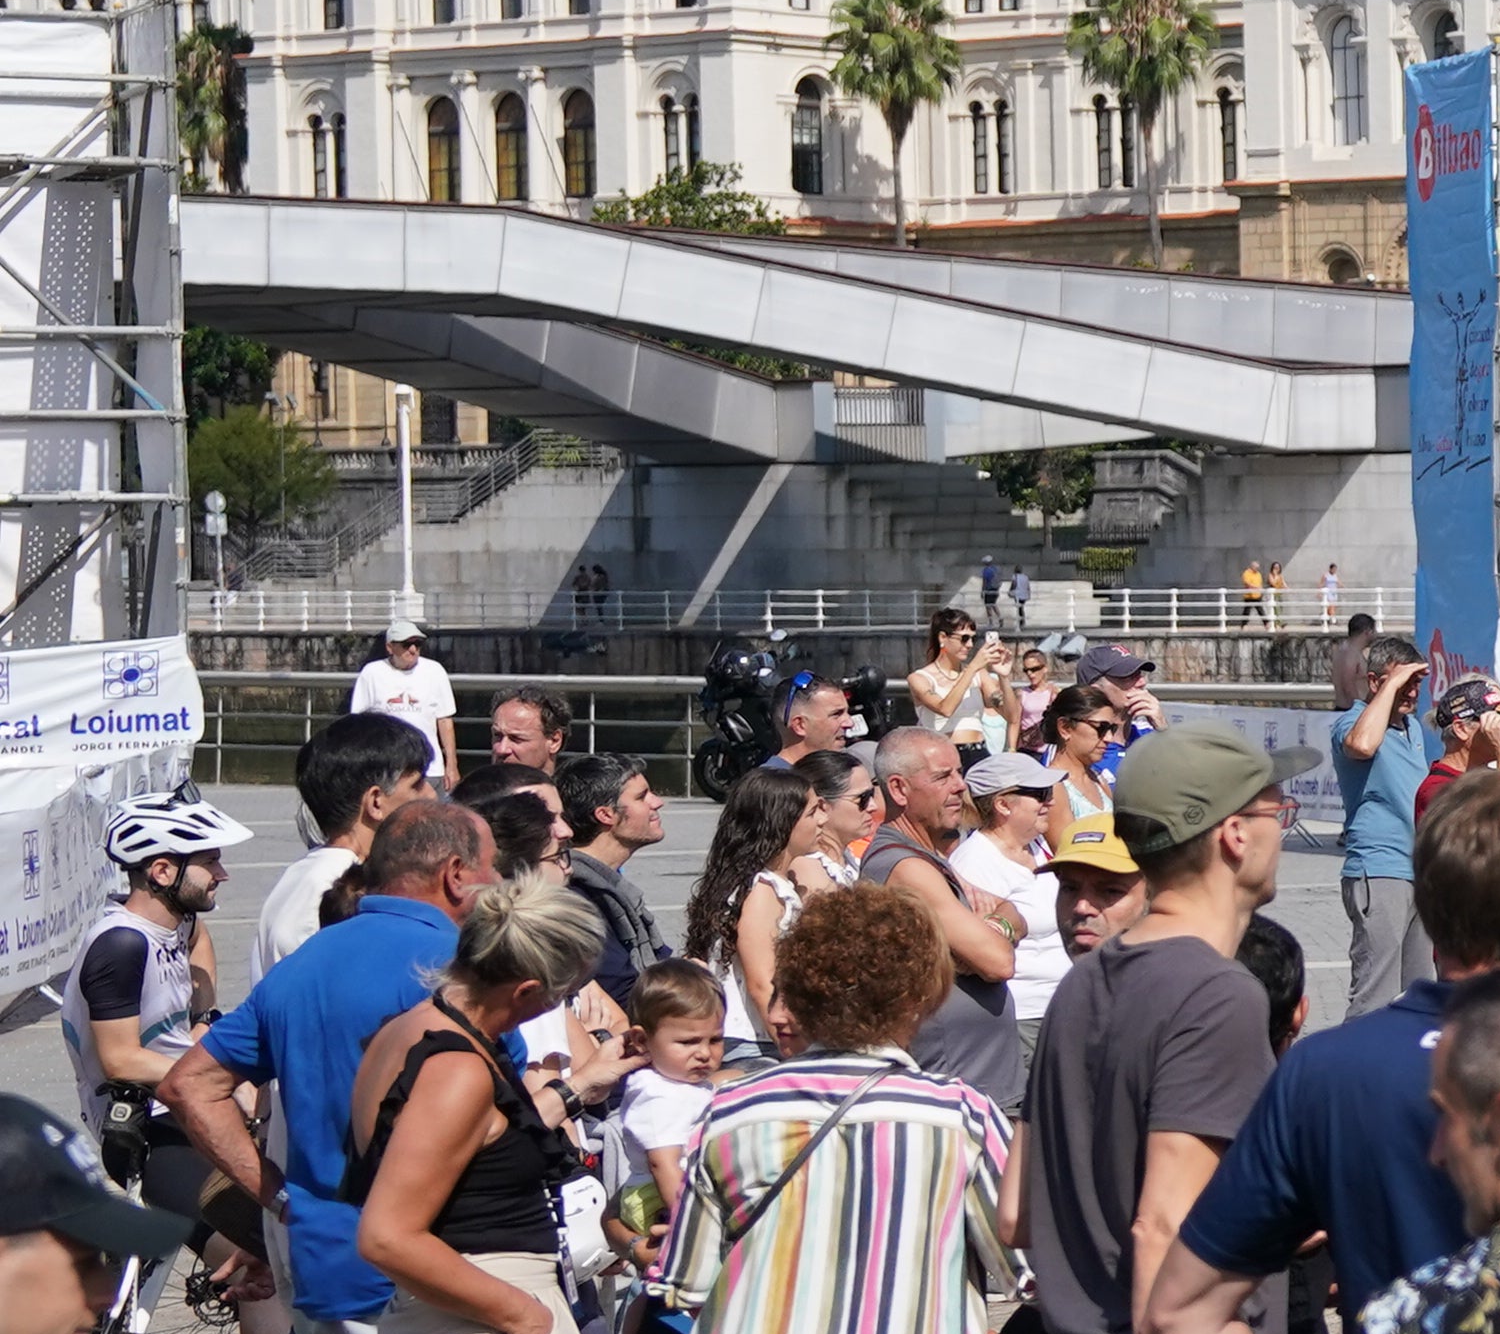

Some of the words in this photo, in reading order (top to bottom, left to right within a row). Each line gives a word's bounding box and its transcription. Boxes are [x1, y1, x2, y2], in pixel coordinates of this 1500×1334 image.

[1419, 125, 1481, 179] Bilbao
[70, 707, 191, 734] Loiumat
[72, 742, 113, 752] JORGE
